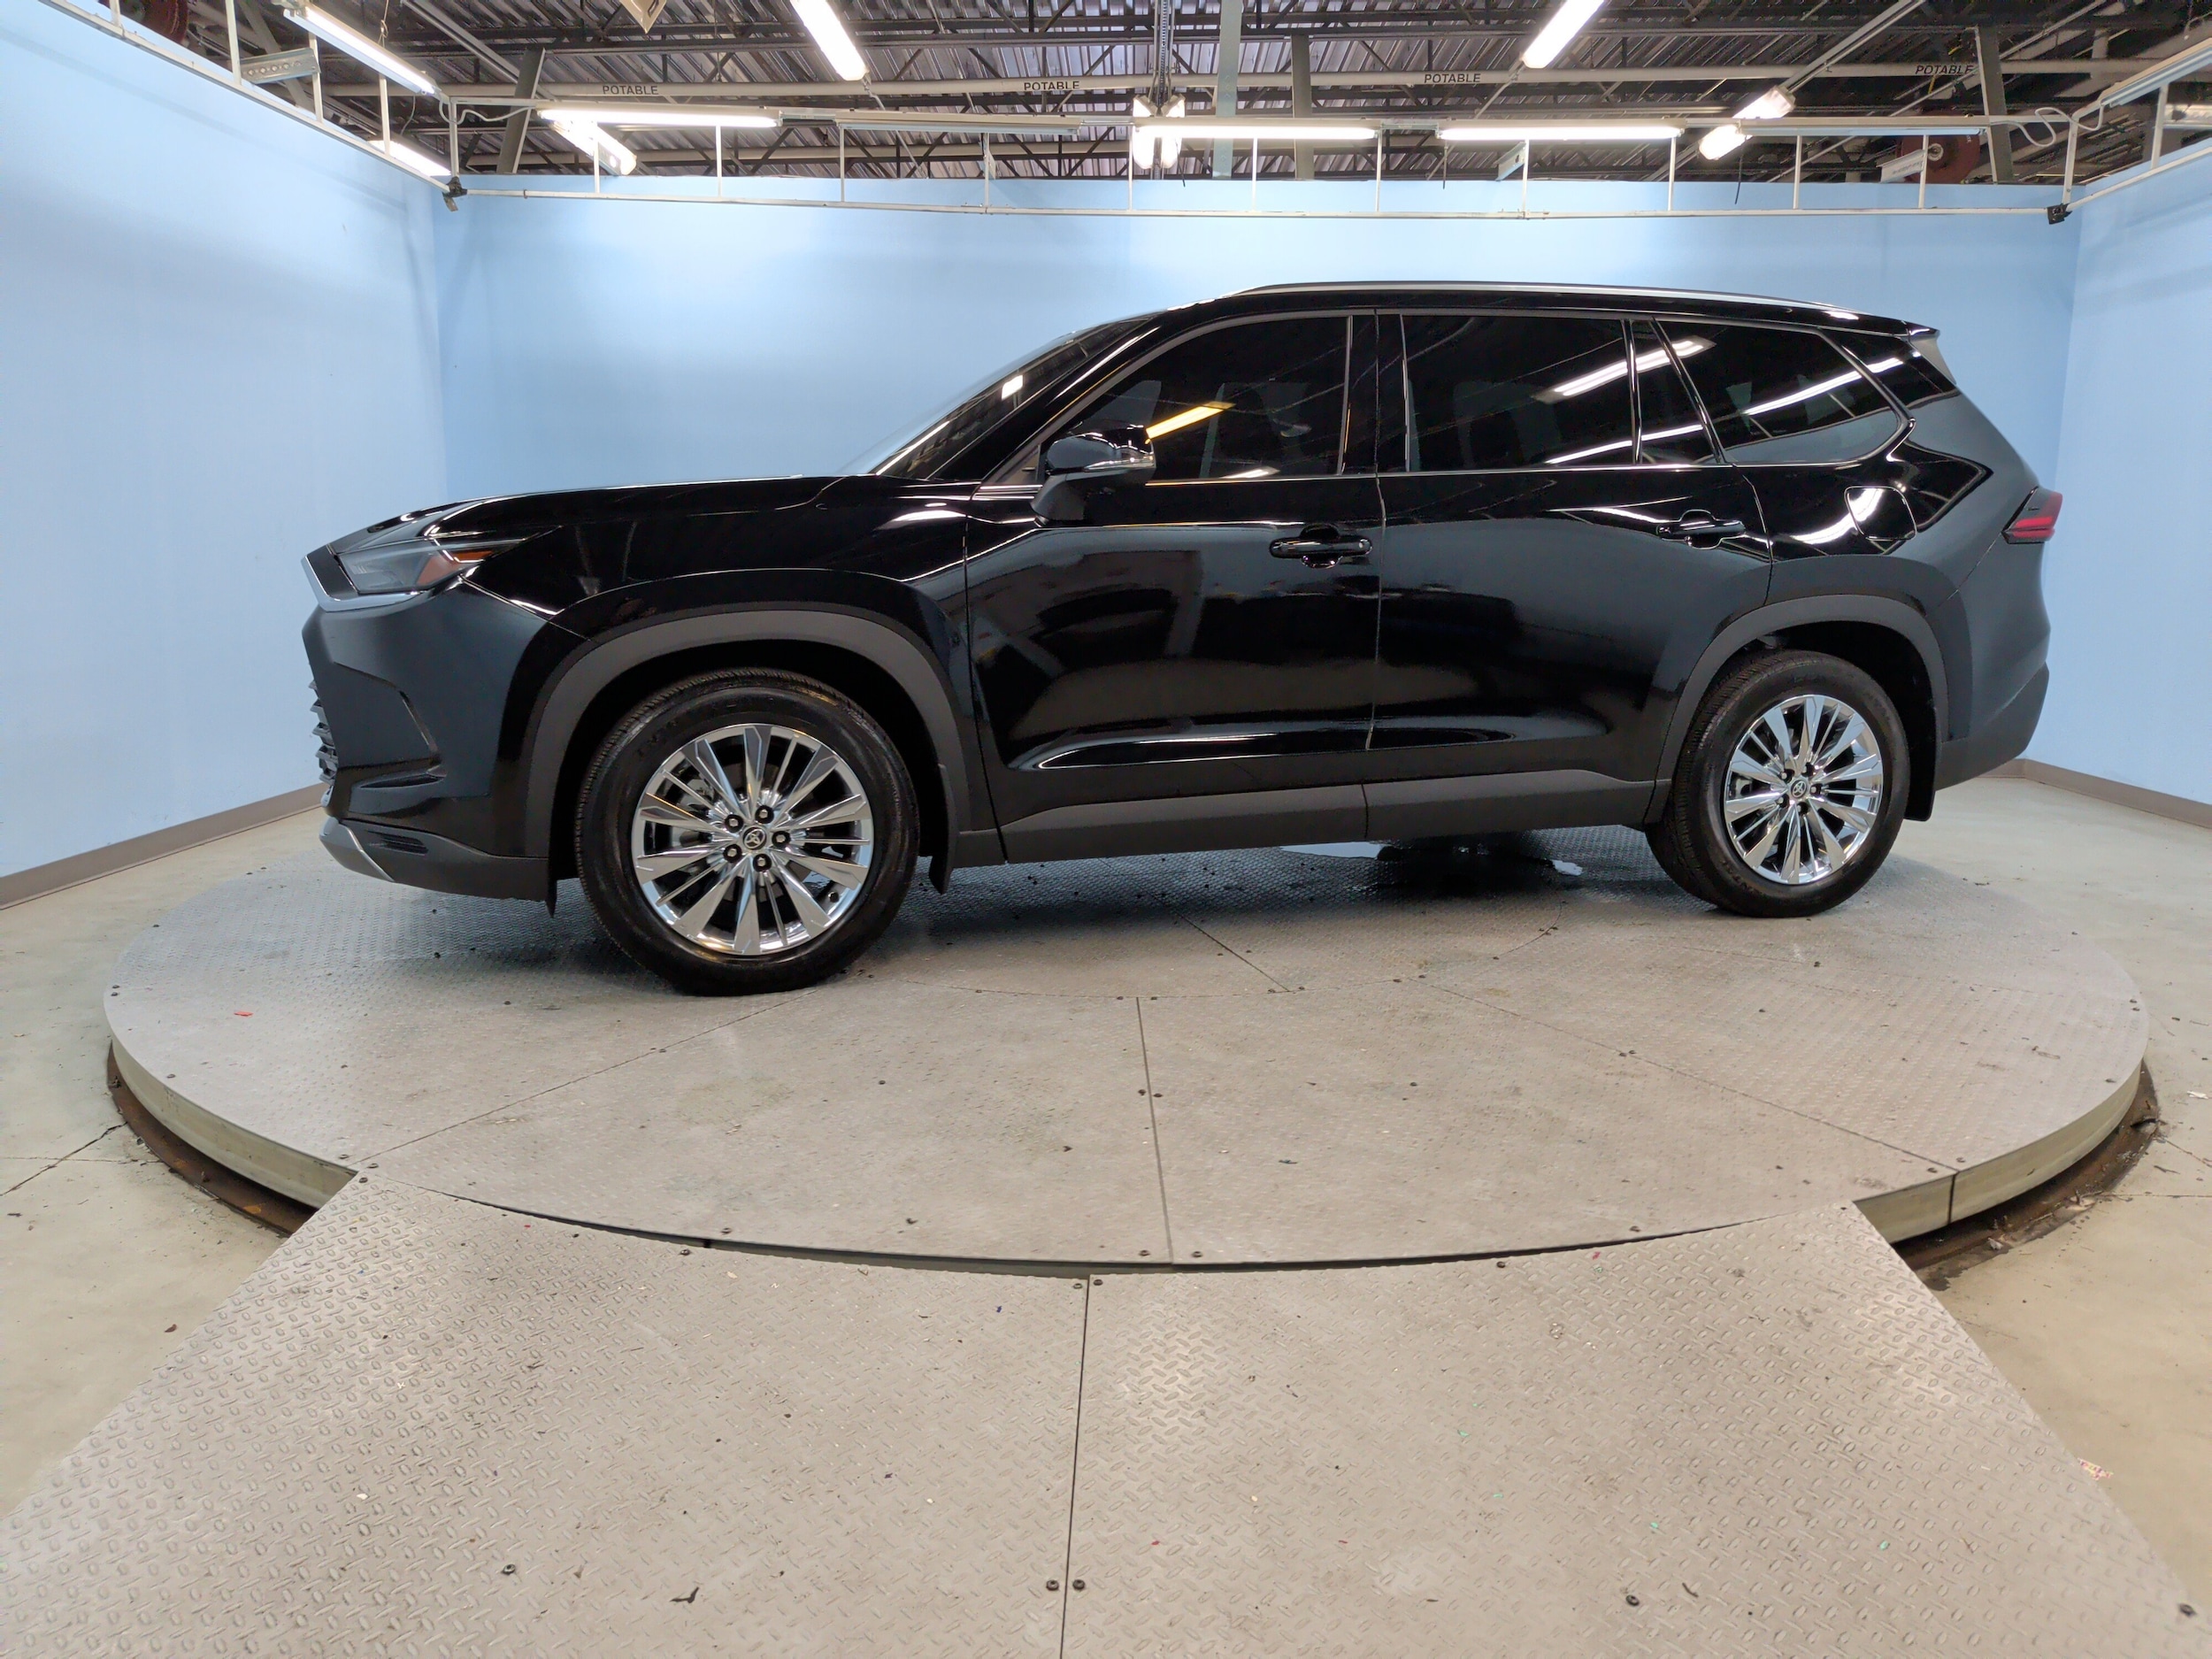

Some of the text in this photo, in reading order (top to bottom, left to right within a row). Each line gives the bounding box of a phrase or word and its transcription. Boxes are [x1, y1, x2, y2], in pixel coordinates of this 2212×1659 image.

[1915, 65, 1974, 74] POTABLE
[1424, 73, 1481, 83] POTABLE
[603, 85, 659, 95] POTABLE
[1024, 81, 1080, 90] POTABLE
